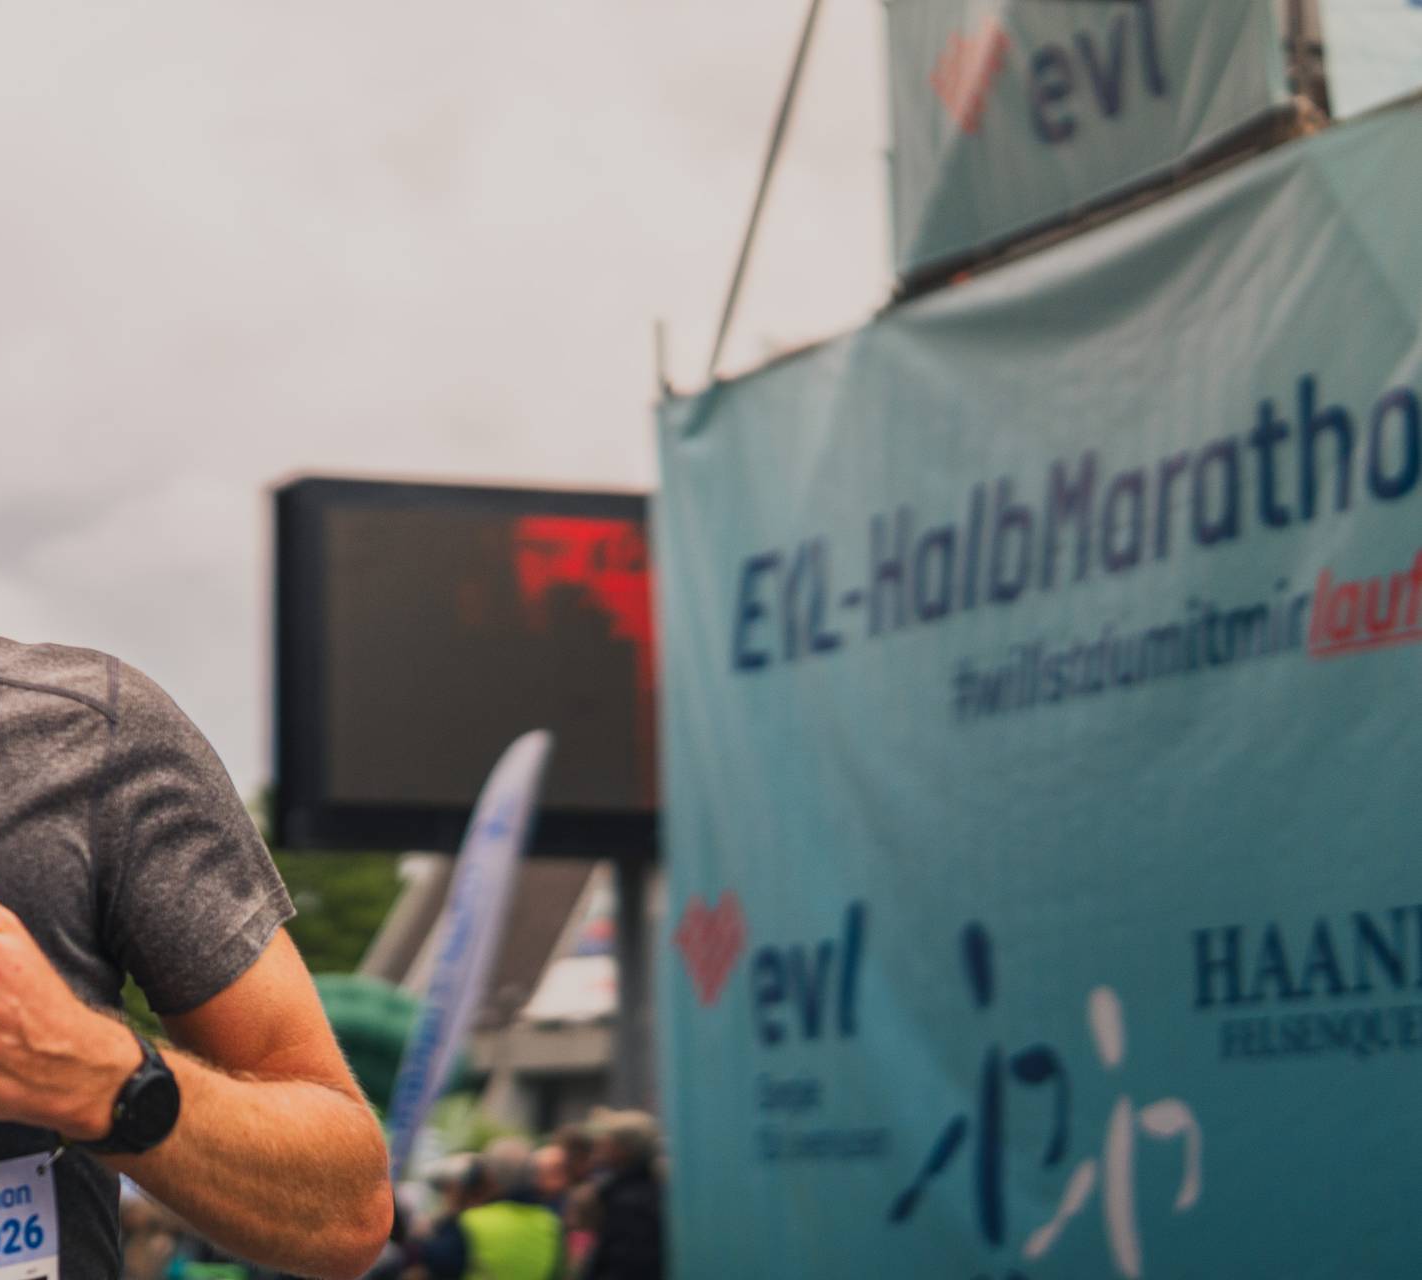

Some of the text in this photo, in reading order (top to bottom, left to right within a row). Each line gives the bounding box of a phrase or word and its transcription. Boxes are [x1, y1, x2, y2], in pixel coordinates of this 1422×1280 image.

[1028, 0, 1167, 144] evl
[751, 900, 866, 1046] evl
[1192, 904, 1422, 1012] HAAN
